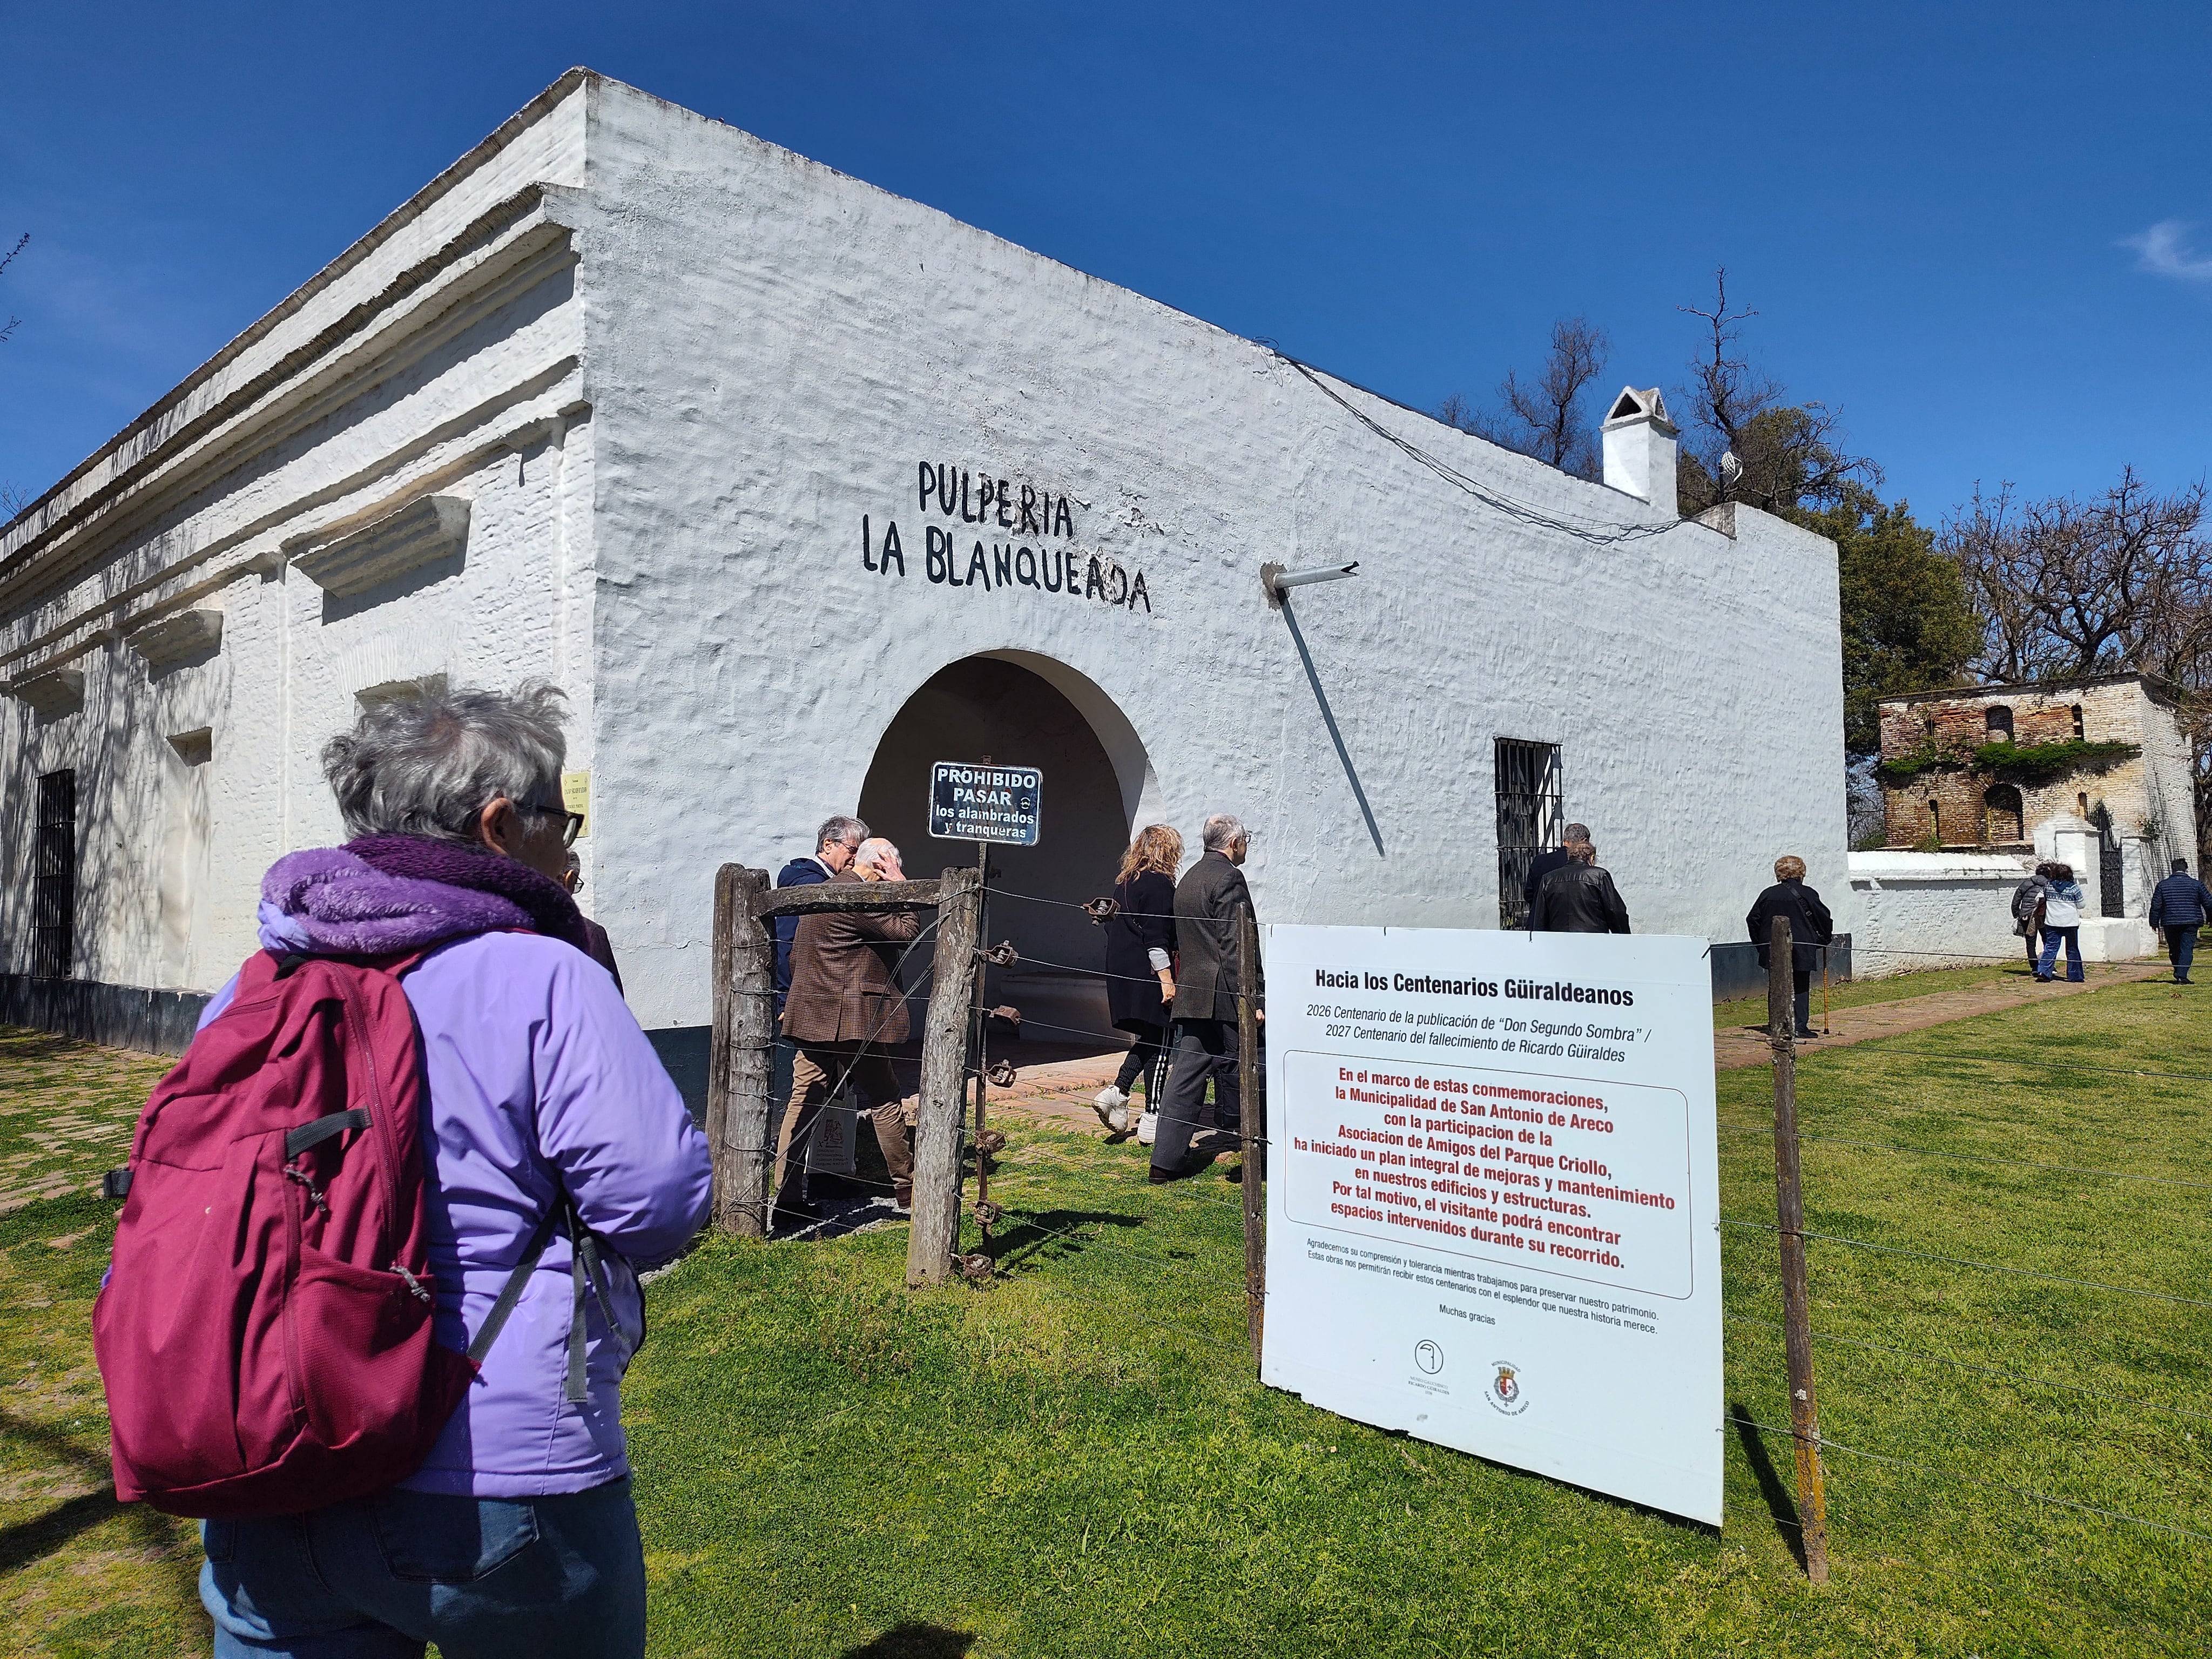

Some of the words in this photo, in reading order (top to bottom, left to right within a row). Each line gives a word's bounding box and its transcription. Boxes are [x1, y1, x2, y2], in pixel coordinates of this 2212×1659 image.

[919, 461, 1074, 538] PULPERIA
[862, 514, 905, 577] LA
[925, 525, 1151, 613] BLANQUEADA
[938, 768, 1036, 788] PROHIBIDO
[953, 787, 1011, 805] PASAR
[936, 805, 955, 818] los
[958, 806, 1034, 824] alambrados
[945, 822, 953, 834] y
[956, 821, 1027, 838] tranqueras
[1316, 969, 1358, 988] Hacia
[1364, 972, 1388, 990] los
[1393, 973, 1498, 997] Centenarios
[1504, 979, 1633, 1006] Güiraldeanos
[1306, 1004, 1331, 1017] 2026
[1334, 1006, 1386, 1021] Centenario
[1389, 1009, 1401, 1022] de
[1405, 1010, 1413, 1023] la
[1416, 1012, 1478, 1028] publicación
[1481, 1016, 1495, 1030] de
[1499, 1017, 1527, 1032] “Don
[1530, 1019, 1582, 1037] Segundo
[1586, 1023, 1642, 1041] Sombra”
[1644, 1029, 1651, 1043] /
[1325, 1024, 1351, 1037] 2027
[1353, 1026, 1406, 1042] Centenario
[1410, 1030, 1426, 1044] del
[1428, 1031, 1498, 1050] fallecimiento
[1501, 1038, 1515, 1051] de
[1519, 1039, 1563, 1056] Ricardo
[1567, 1043, 1625, 1062] Güiraldes
[1336, 1085, 1345, 1100] la
[1350, 1087, 1436, 1110] Municipalidad
[1441, 1098, 1456, 1112] de
[1460, 1100, 1486, 1116] San
[1489, 1103, 1543, 1124] Antonio
[1548, 1111, 1565, 1127] de
[1569, 1114, 1613, 1133] Areco
[1339, 1067, 1353, 1081] En
[1357, 1069, 1367, 1083] el
[1371, 1073, 1410, 1087] marco
[1414, 1075, 1429, 1089] de
[1433, 1078, 1468, 1094] estas
[1472, 1083, 1608, 1114] conmemoraciones,
[1338, 1124, 1403, 1146] Asociacion
[1407, 1134, 1422, 1149] de
[1426, 1136, 1475, 1157] Amigos
[1480, 1144, 1500, 1160] del
[1505, 1147, 1554, 1169] Parque
[1559, 1155, 1611, 1181] Criollo,
[1384, 1114, 1406, 1127] con
[1410, 1114, 1421, 1128] la
[1426, 1119, 1513, 1141] participacion
[1518, 1128, 1535, 1144] de
[1539, 1130, 1552, 1147] la
[1294, 1136, 1307, 1151] ha
[1311, 1139, 1357, 1158] iniciado
[1360, 1149, 1375, 1162] un
[1379, 1150, 1405, 1166] plan
[1410, 1154, 1459, 1175] integral
[1463, 1162, 1479, 1177] de
[1483, 1168, 1540, 1188] mejoras
[1545, 1177, 1553, 1192] y
[1557, 1179, 1675, 1210] mantenimiento
[1354, 1168, 1368, 1180] en
[1373, 1171, 1426, 1189] nuestros
[1431, 1178, 1487, 1199] edificios
[1491, 1190, 1499, 1204] y
[1503, 1191, 1590, 1218] estructuras.
[1331, 1202, 1383, 1222] espacios
[1387, 1209, 1466, 1237] intervenidos
[1471, 1225, 1523, 1249] durante
[1528, 1239, 1545, 1253] su
[1550, 1243, 1624, 1269] recorrido.
[1332, 1181, 1352, 1196] Por
[1355, 1185, 1371, 1199] tal
[1375, 1191, 1420, 1211] motivo,
[1425, 1197, 1435, 1211] el
[1440, 1199, 1498, 1223] visitante
[1502, 1213, 1542, 1231] podrá
[1547, 1221, 1621, 1245] encontrar
[1306, 1238, 1348, 1254] Agradecemos
[1359, 1250, 1401, 1265] comprensión
[1403, 1259, 1407, 1267] y
[1409, 1259, 1442, 1274] tolerancia
[1444, 1267, 1475, 1280] mientras
[1476, 1273, 1518, 1290] trabajamos
[1520, 1284, 1537, 1294] para
[1539, 1287, 1576, 1302] preservar
[1579, 1296, 1609, 1310] nuestro
[1611, 1303, 1658, 1320] patrimonio.
[1308, 1250, 1324, 1261] Estas
[1325, 1255, 1343, 1265] obras
[1345, 1259, 1356, 1267] nos
[1358, 1262, 1391, 1275] permitirán
[1393, 1270, 1414, 1280] recibir
[1415, 1274, 1434, 1285] estos
[1435, 1279, 1476, 1294] centenarios
[1478, 1288, 1492, 1297] con
[1493, 1291, 1500, 1299] el
[1502, 1293, 1540, 1308] esplendor
[1541, 1302, 1556, 1312] que
[1559, 1305, 1588, 1319] nuestra
[1591, 1311, 1621, 1326] historia
[1623, 1320, 1657, 1334] merece.
[1439, 1304, 1467, 1318] Muchas
[1469, 1312, 1495, 1325] gracias
[1489, 1401, 1510, 1416] ANTONIO
[1518, 1400, 1530, 1414] ARECO
